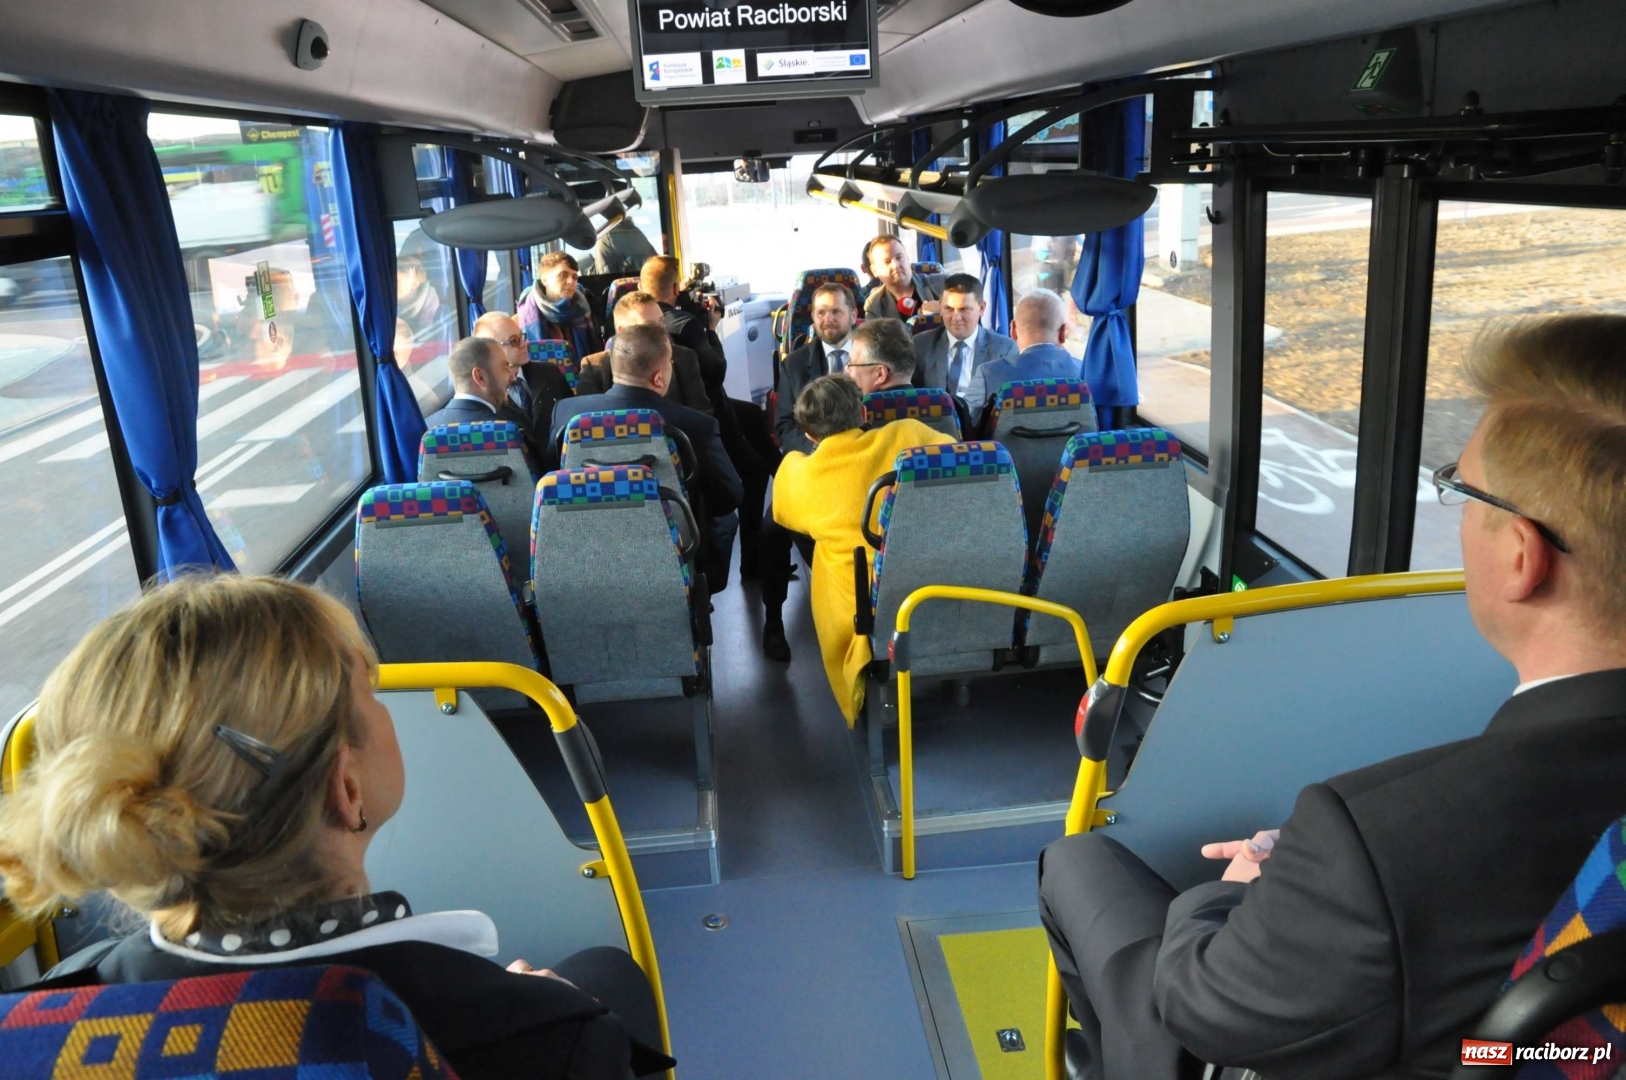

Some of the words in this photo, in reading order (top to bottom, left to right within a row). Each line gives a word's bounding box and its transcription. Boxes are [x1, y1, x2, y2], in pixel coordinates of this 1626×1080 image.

[658, 8, 731, 30] Powiat
[737, 1, 847, 26] Raciborski
[261, 129, 300, 140] Chempest
